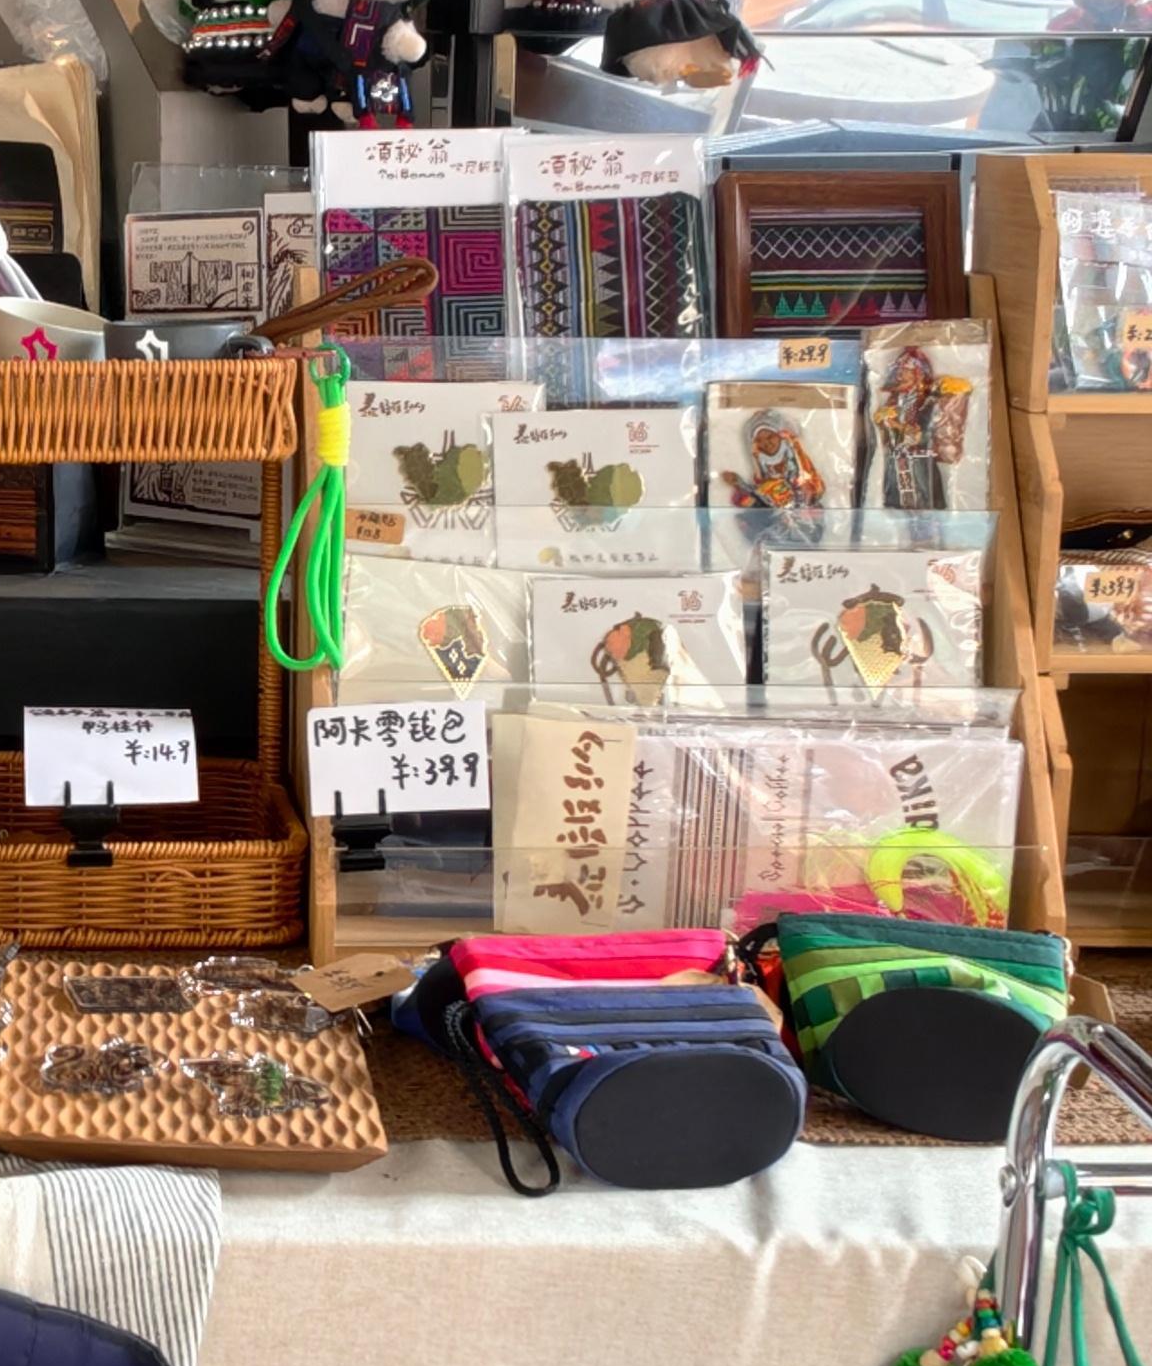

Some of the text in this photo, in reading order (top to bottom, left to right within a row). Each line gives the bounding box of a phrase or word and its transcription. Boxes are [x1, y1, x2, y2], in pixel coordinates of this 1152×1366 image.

[313, 708, 466, 747] 阿卡零钱包
